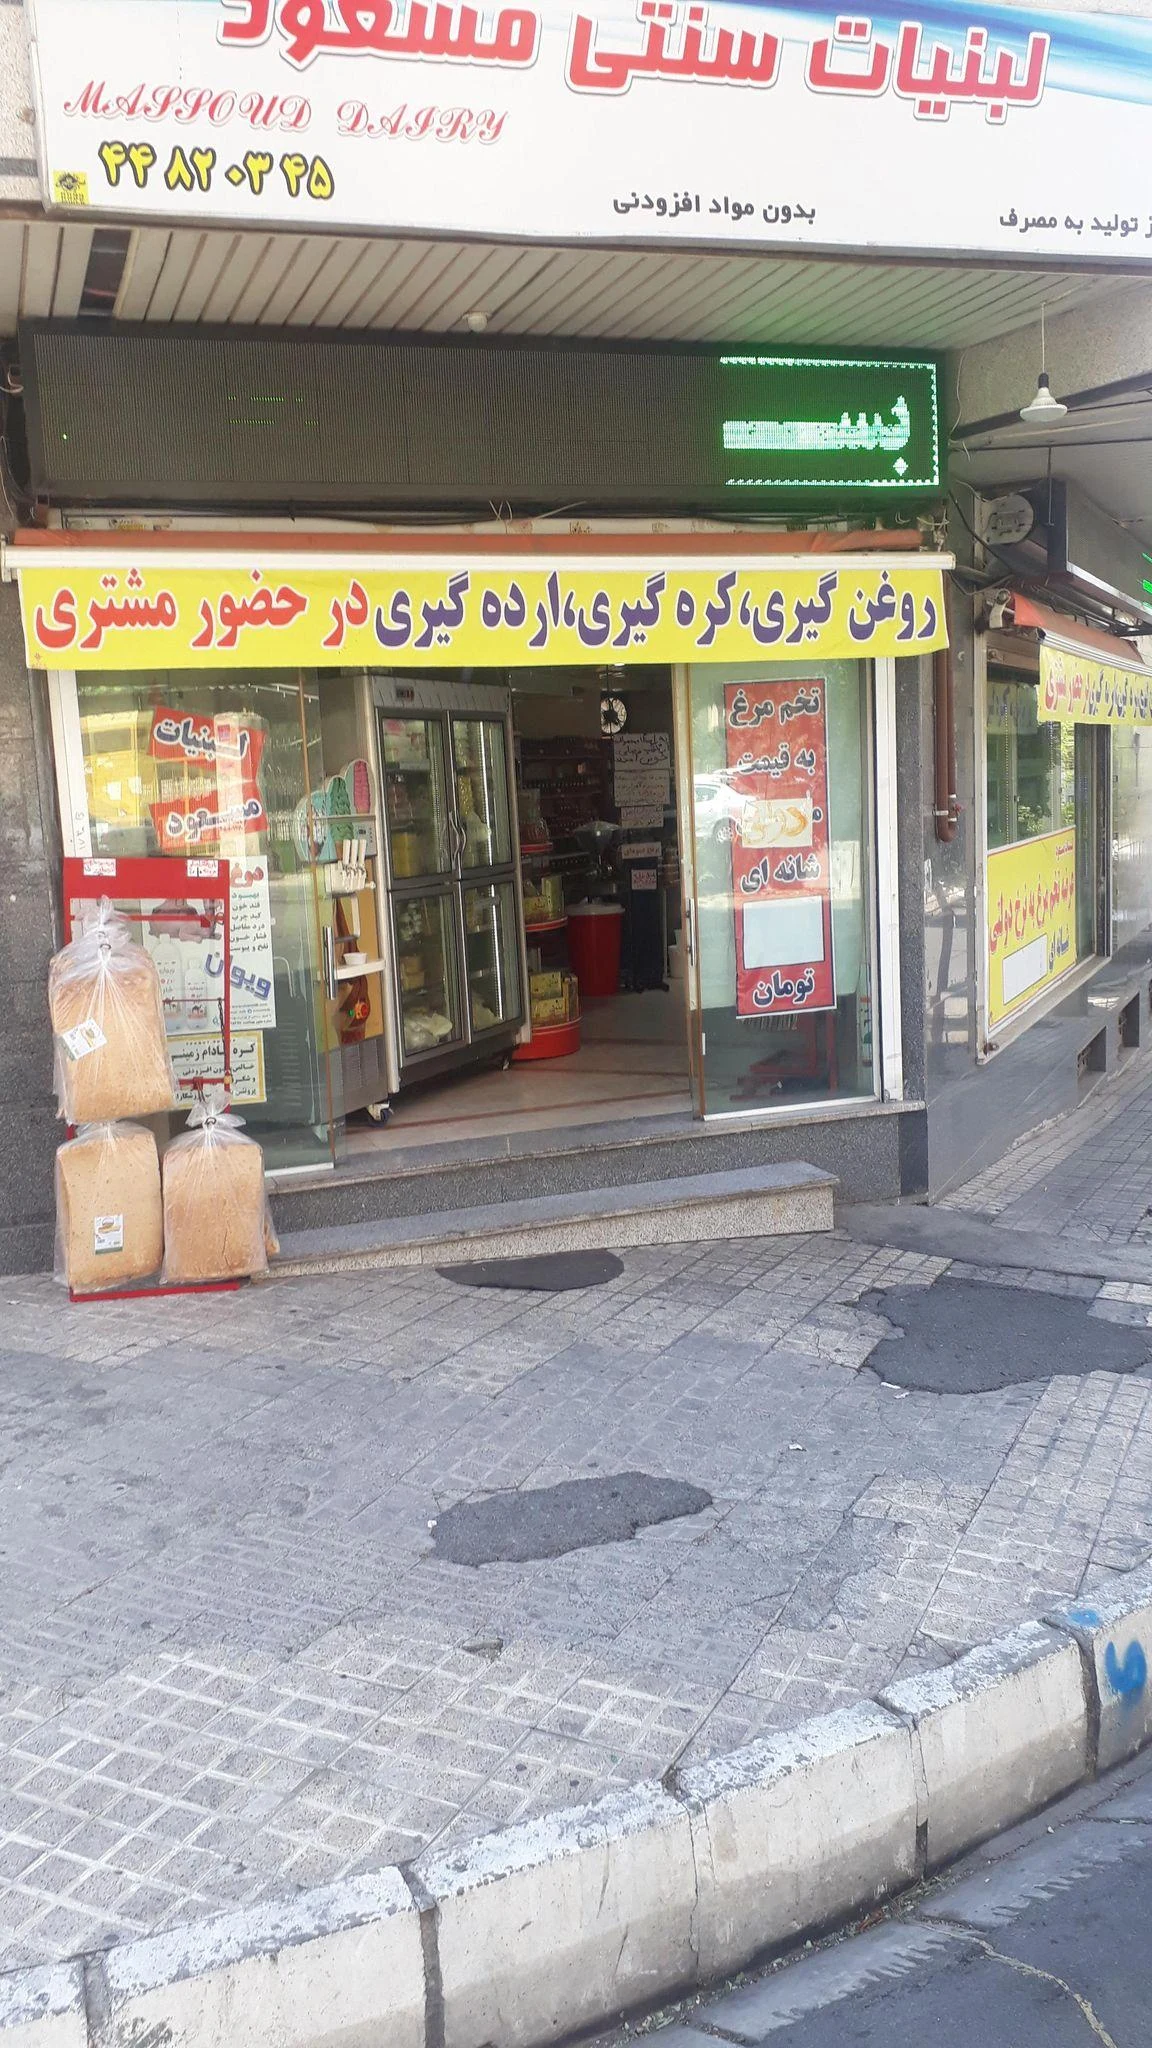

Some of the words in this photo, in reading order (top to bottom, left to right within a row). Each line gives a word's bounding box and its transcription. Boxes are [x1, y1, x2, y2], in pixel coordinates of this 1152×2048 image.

[221, 0, 537, 64] مسعود
[568, 0, 779, 90] سنتی
[807, 20, 1051, 119] لبنیات
[63, 80, 312, 131] MASSOUD
[336, 101, 510, 143] DAIRY
[612, 191, 700, 219] افزودنی
[708, 196, 755, 219] مواد
[762, 201, 816, 225] بدون
[999, 208, 1058, 233] مصرف
[1065, 216, 1084, 235] به
[1091, 214, 1138, 238] تولید
[35, 568, 178, 650] مشتری
[190, 570, 307, 648] حضور
[322, 580, 369, 647] در
[375, 571, 471, 648] گیری
[848, 571, 936, 641] روغن
[729, 690, 774, 727] مرغ
[779, 687, 821, 725] تخم
[156, 717, 249, 759] لبنیات
[738, 743, 791, 779] قیمت
[795, 747, 816, 776] به
[740, 858, 768, 893] ای
[774, 854, 821, 883] شانه
[753, 969, 815, 1007] تومان
